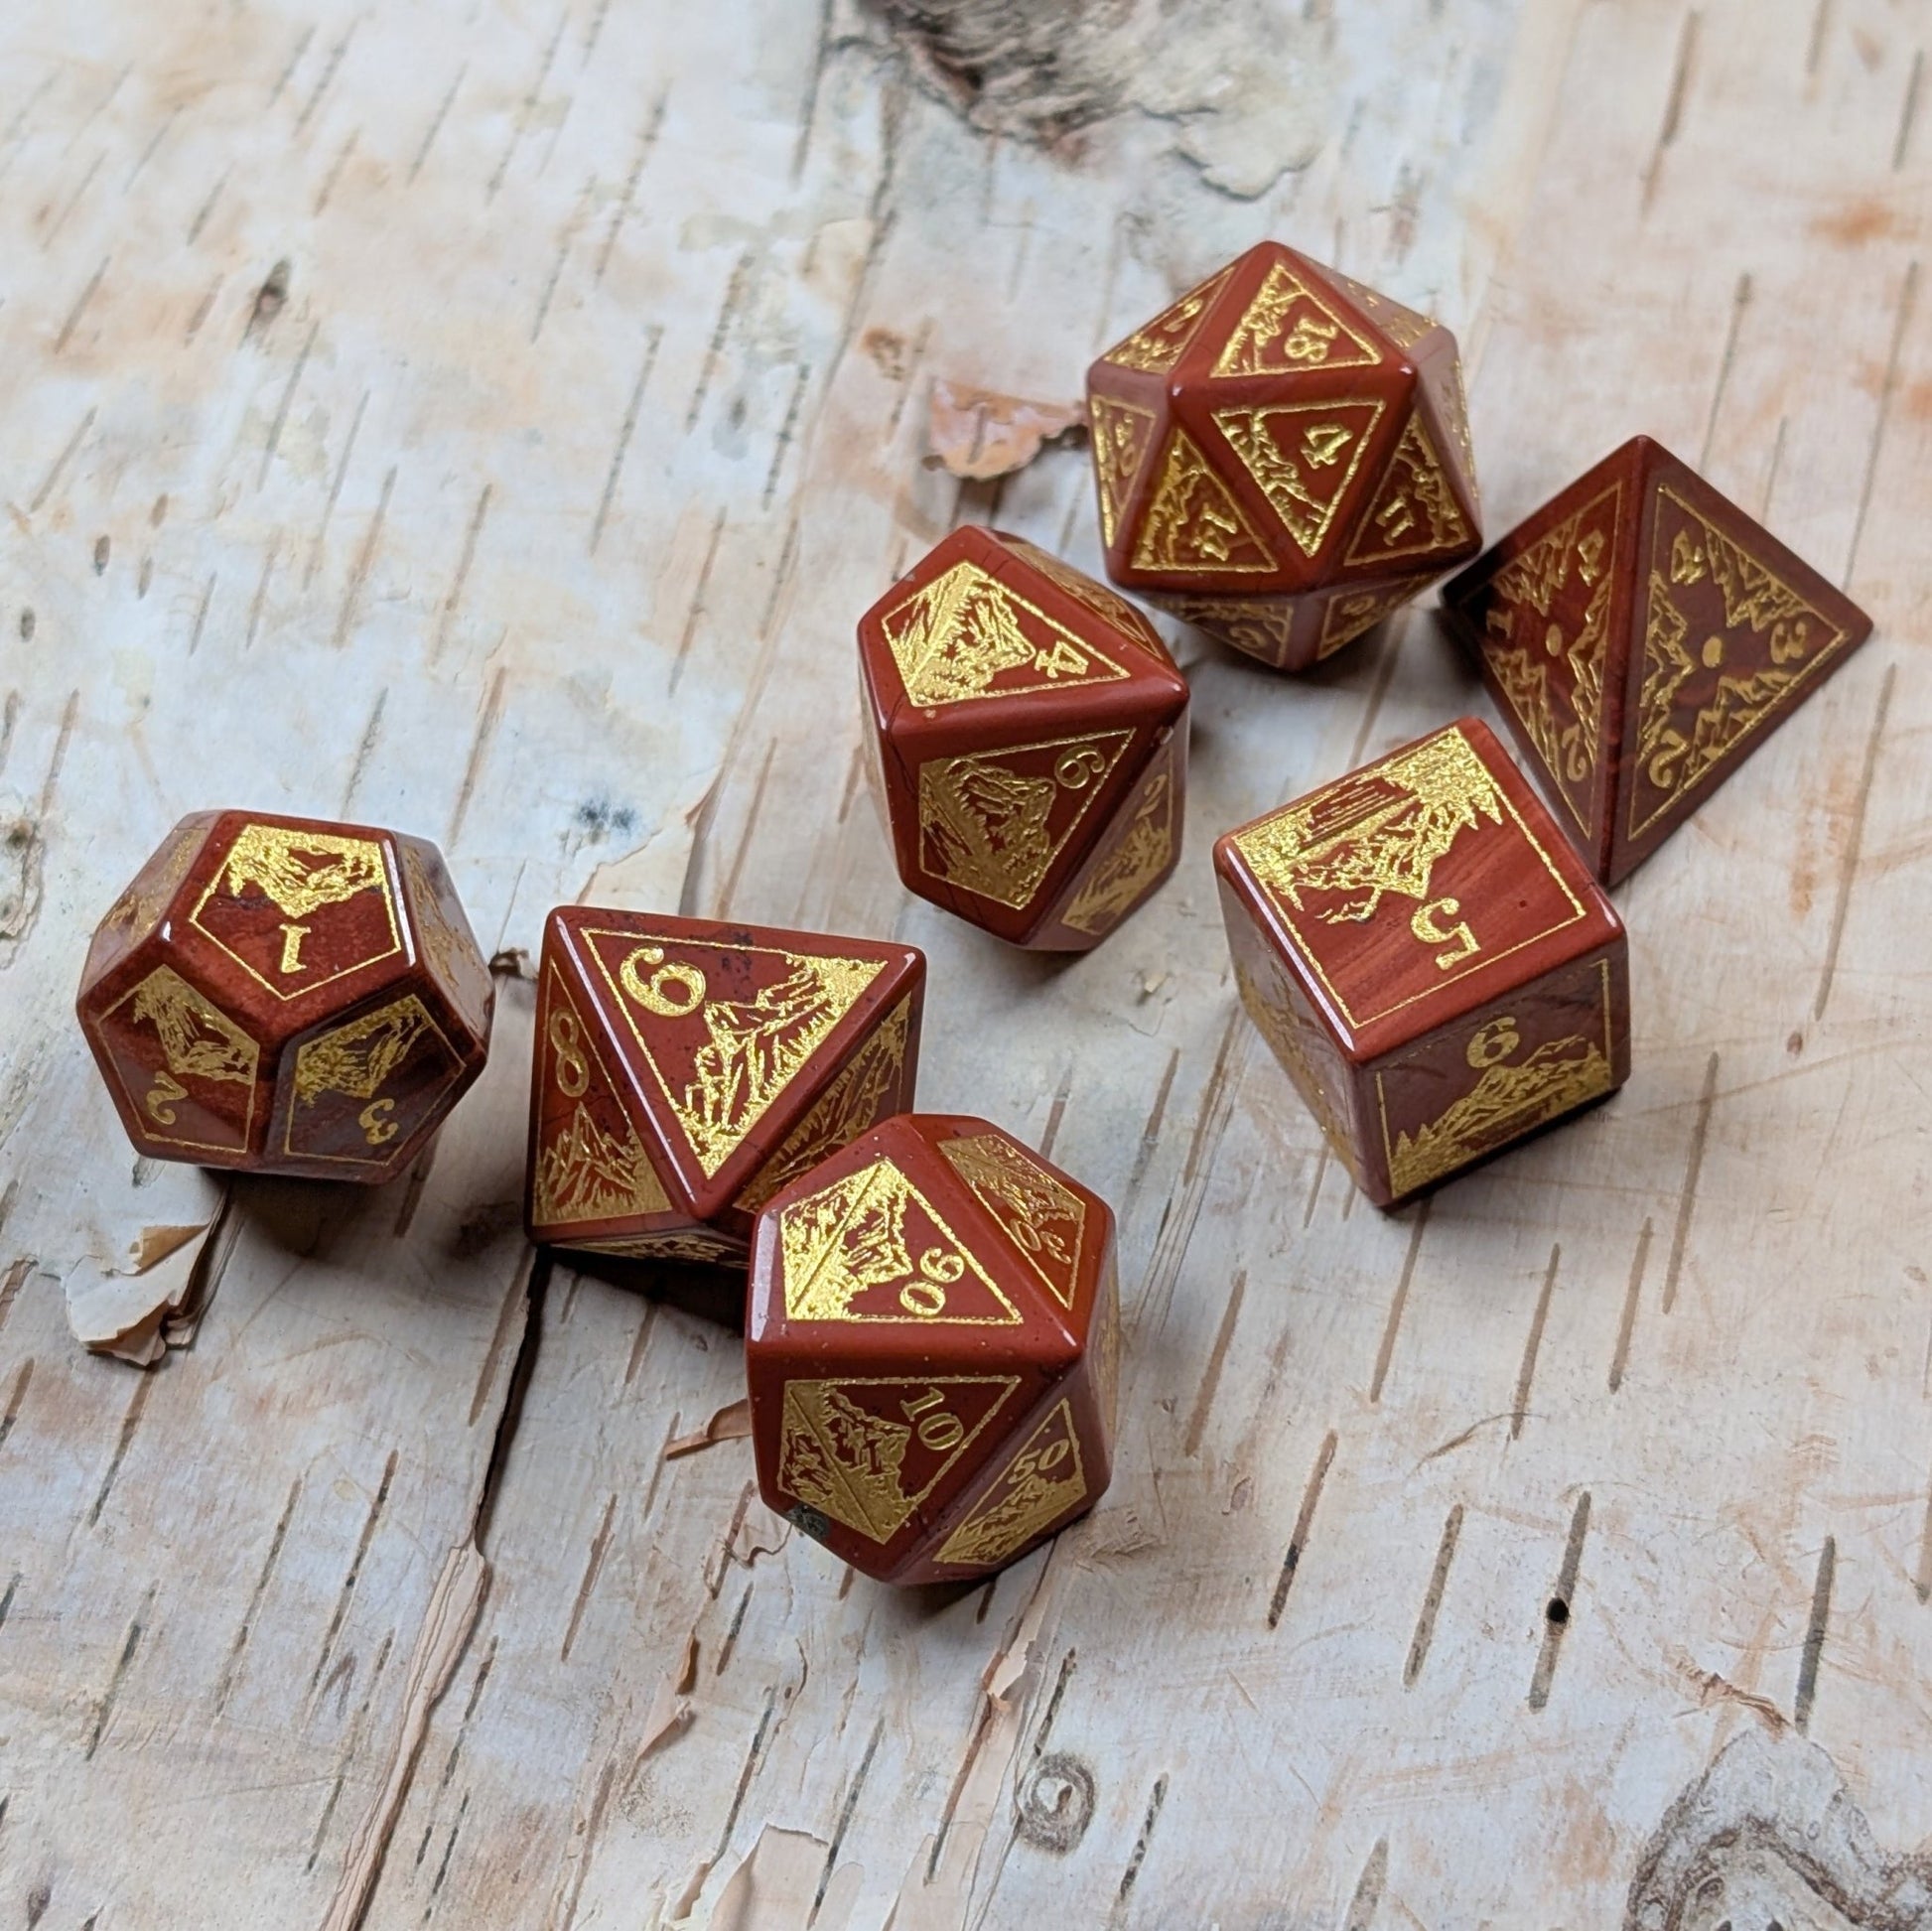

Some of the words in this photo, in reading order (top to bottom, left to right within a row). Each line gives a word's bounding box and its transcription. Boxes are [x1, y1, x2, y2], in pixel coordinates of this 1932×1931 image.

[1284, 317, 1339, 363] 18
[1300, 423, 1354, 471] 4
[1189, 501, 1238, 562] 14
[1374, 496, 1416, 546] 11
[1577, 527, 1606, 587] 4
[1670, 528, 1708, 585] 4
[1034, 640, 1090, 679] 4
[1769, 621, 1808, 665] 3
[1561, 724, 1587, 783] 2
[1648, 729, 1689, 789] 2
[278, 922, 312, 975] 1
[1410, 897, 1482, 971] 5
[619, 944, 708, 1018] 6
[549, 1007, 591, 1098] 8
[1465, 1015, 1521, 1070] 6
[145, 1070, 189, 1126] 2
[358, 1097, 399, 1146] 3
[1009, 1217, 1073, 1265] 30
[898, 1246, 966, 1317] 90
[898, 1386, 965, 1451] 10
[1007, 1438, 1071, 1486] 50
